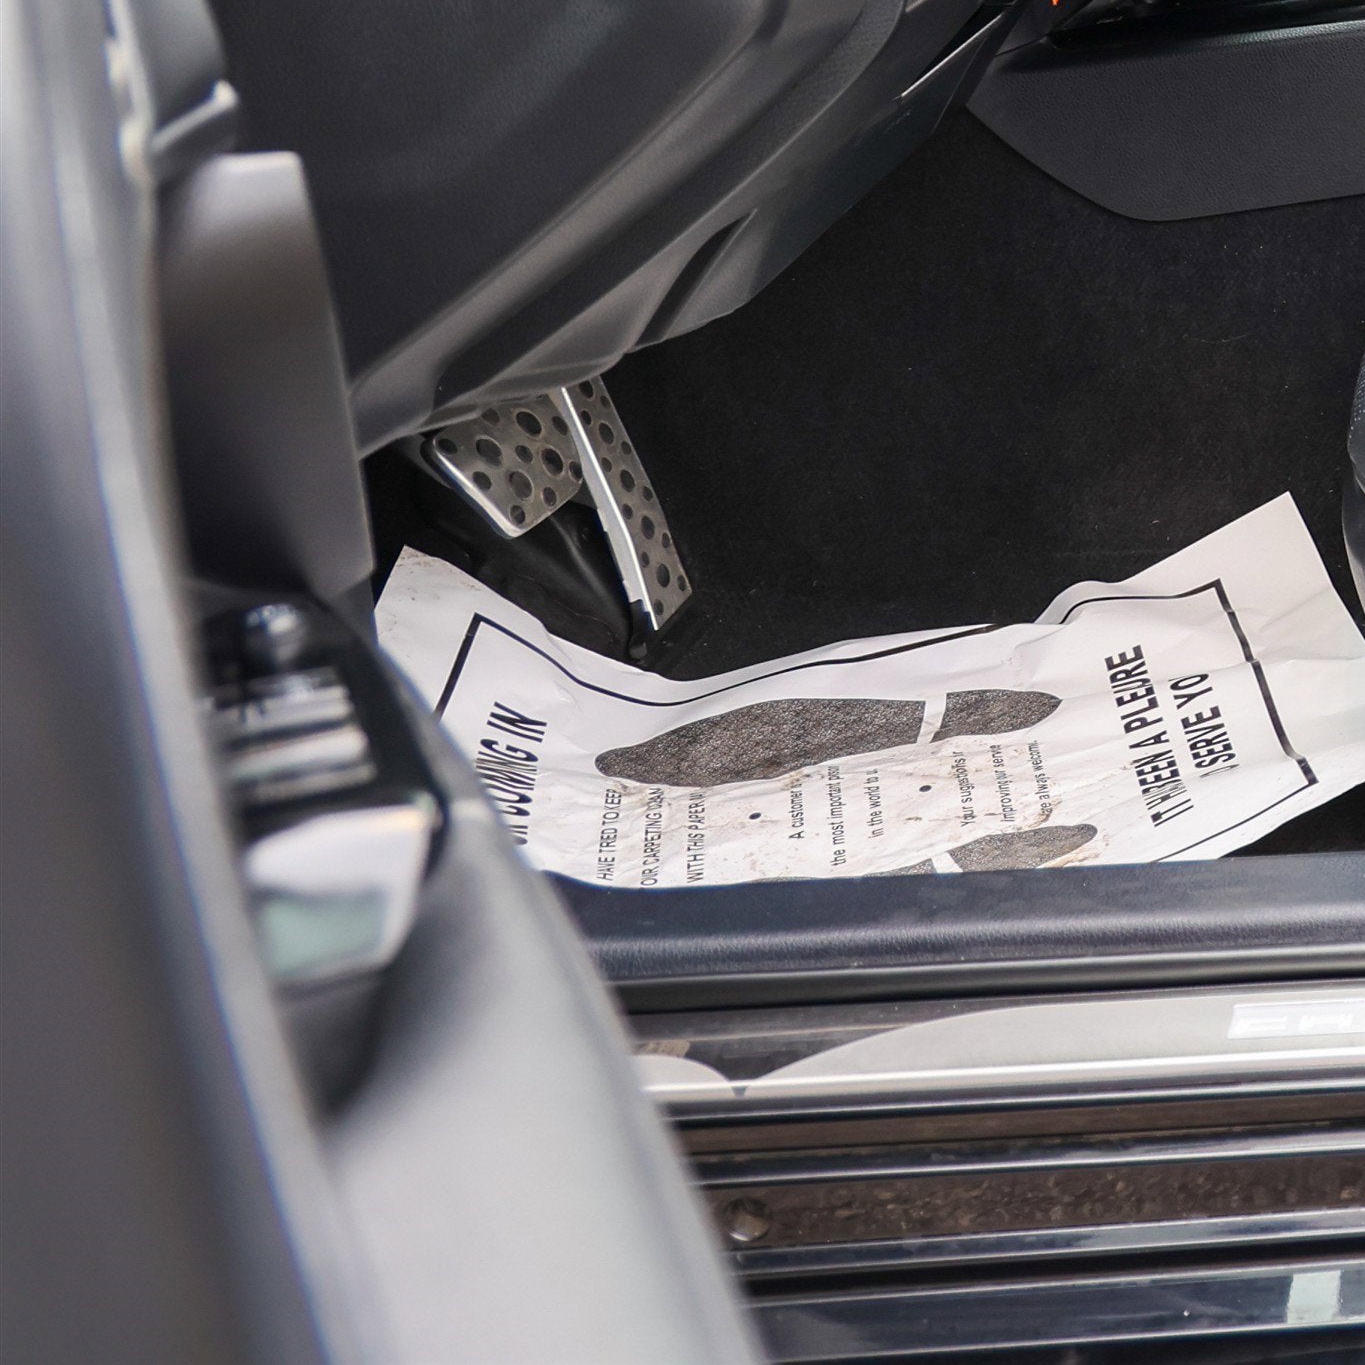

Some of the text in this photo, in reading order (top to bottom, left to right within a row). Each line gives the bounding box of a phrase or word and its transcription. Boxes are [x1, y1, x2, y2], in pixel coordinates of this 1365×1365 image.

[486, 701, 547, 743] IN
[1129, 730, 1170, 749] A
[1181, 706, 1236, 769] SERVE
[864, 786, 881, 809] world
[603, 812, 619, 825] TO
[688, 802, 706, 830] PAPER
[789, 791, 804, 828] customer
[867, 810, 883, 826] the
[960, 806, 976, 827] Your
[1150, 798, 1194, 827] IT
[599, 828, 617, 853] TRIED
[643, 813, 662, 865] CARPETING
[688, 833, 705, 851] THIS
[788, 831, 805, 839] A
[830, 821, 844, 845] most
[868, 828, 884, 838] in
[597, 857, 615, 881] HAVE
[687, 854, 705, 883] WITH
[831, 849, 847, 866] the
[641, 866, 659, 886] OUR
